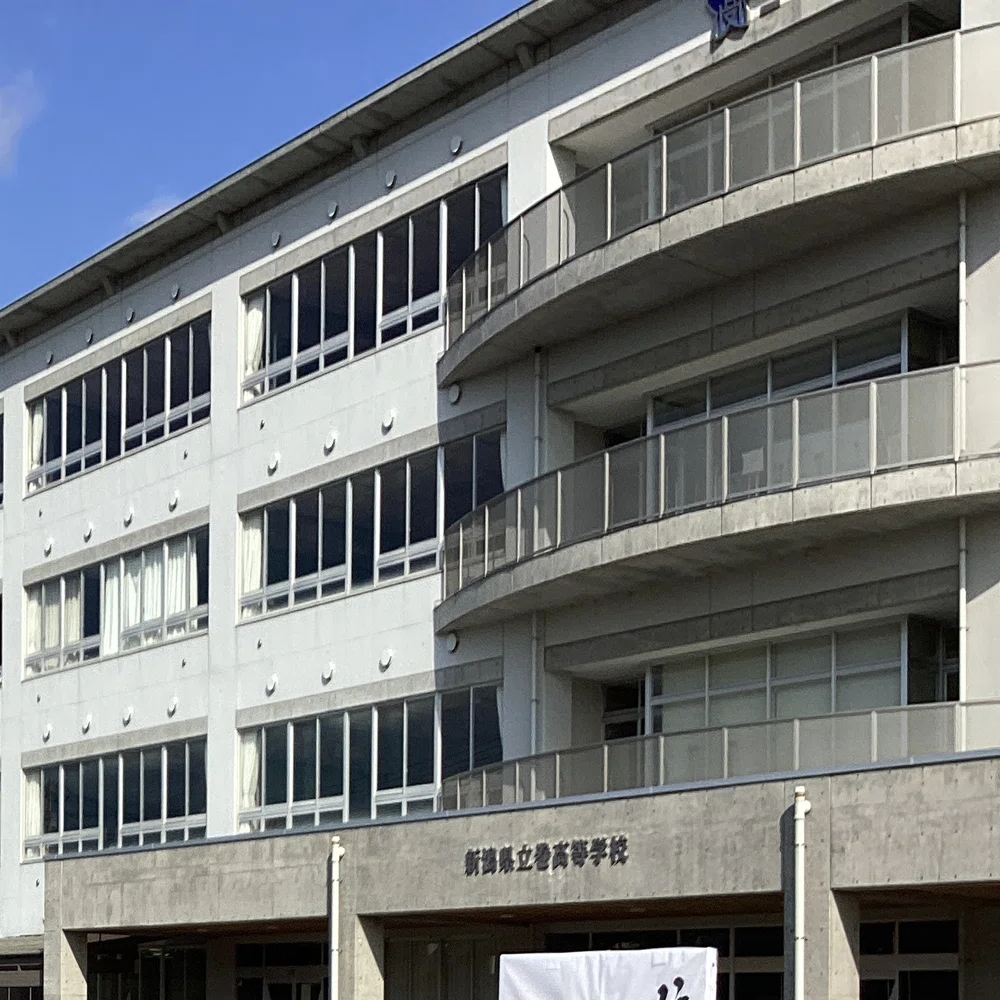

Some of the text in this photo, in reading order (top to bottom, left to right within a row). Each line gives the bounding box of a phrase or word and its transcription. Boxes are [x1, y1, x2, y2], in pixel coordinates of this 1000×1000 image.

[464, 834, 629, 876] 新潟県立巻高等学校
